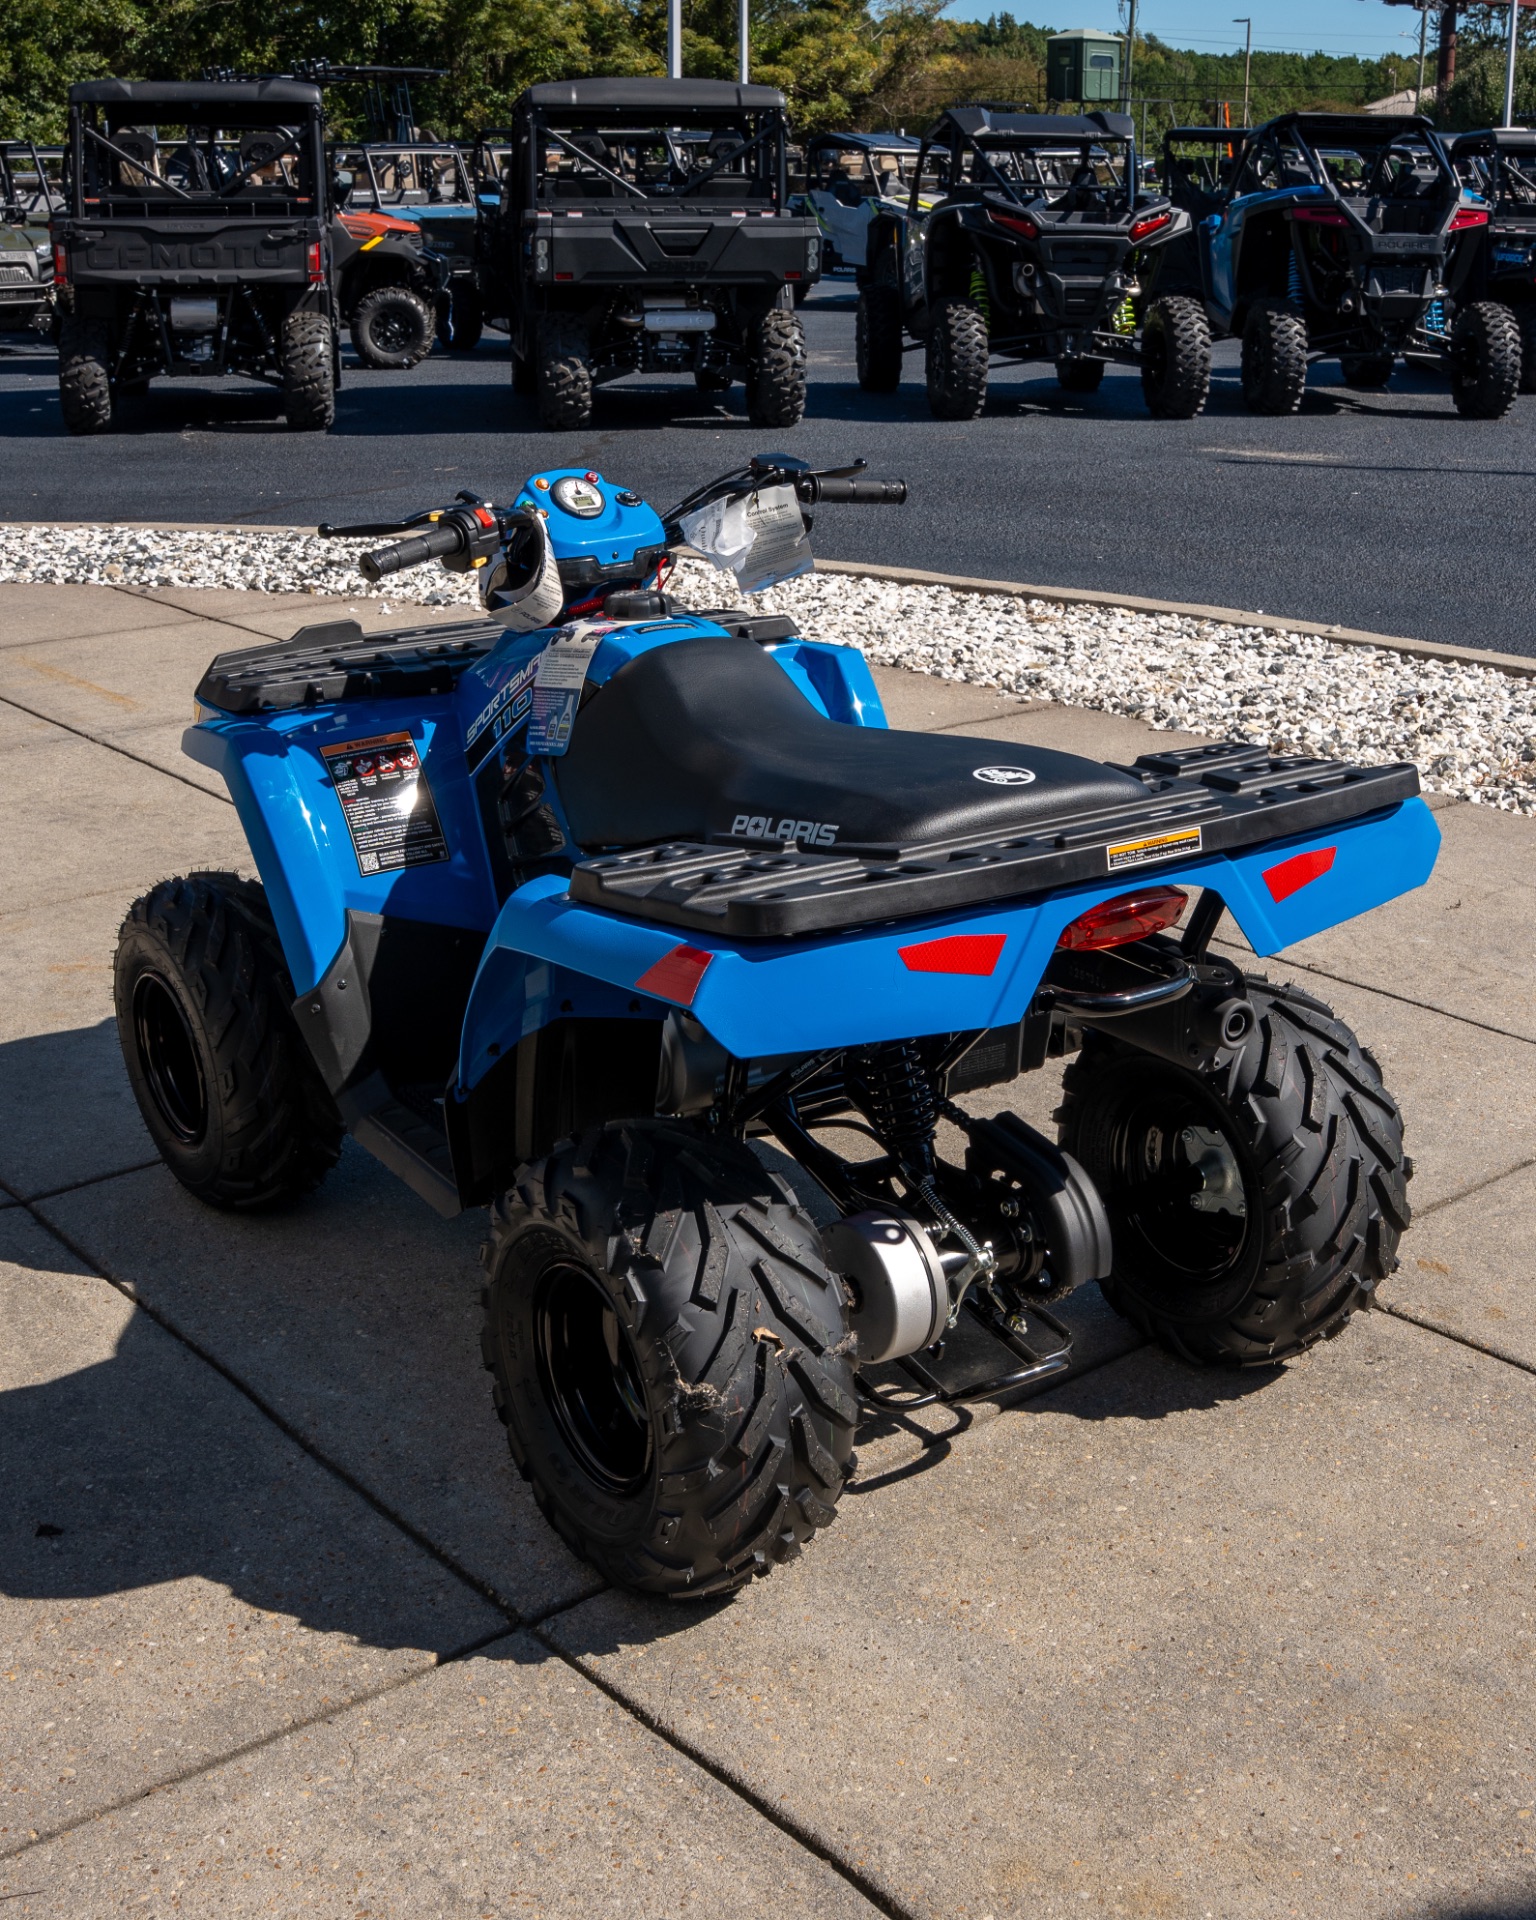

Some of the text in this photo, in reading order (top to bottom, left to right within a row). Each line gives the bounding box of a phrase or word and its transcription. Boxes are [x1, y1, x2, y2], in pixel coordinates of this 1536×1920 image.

[1378, 240, 1430, 250] POLARIS
[86, 244, 287, 269] CFMOTO
[768, 503, 789, 514] System
[520, 611, 543, 625] POLARIS
[466, 652, 541, 740] SPORTSMA
[493, 686, 532, 739] 110
[354, 737, 388, 748] WARNING
[731, 815, 839, 846] POLARIS
[1147, 837, 1169, 847] WARNING
